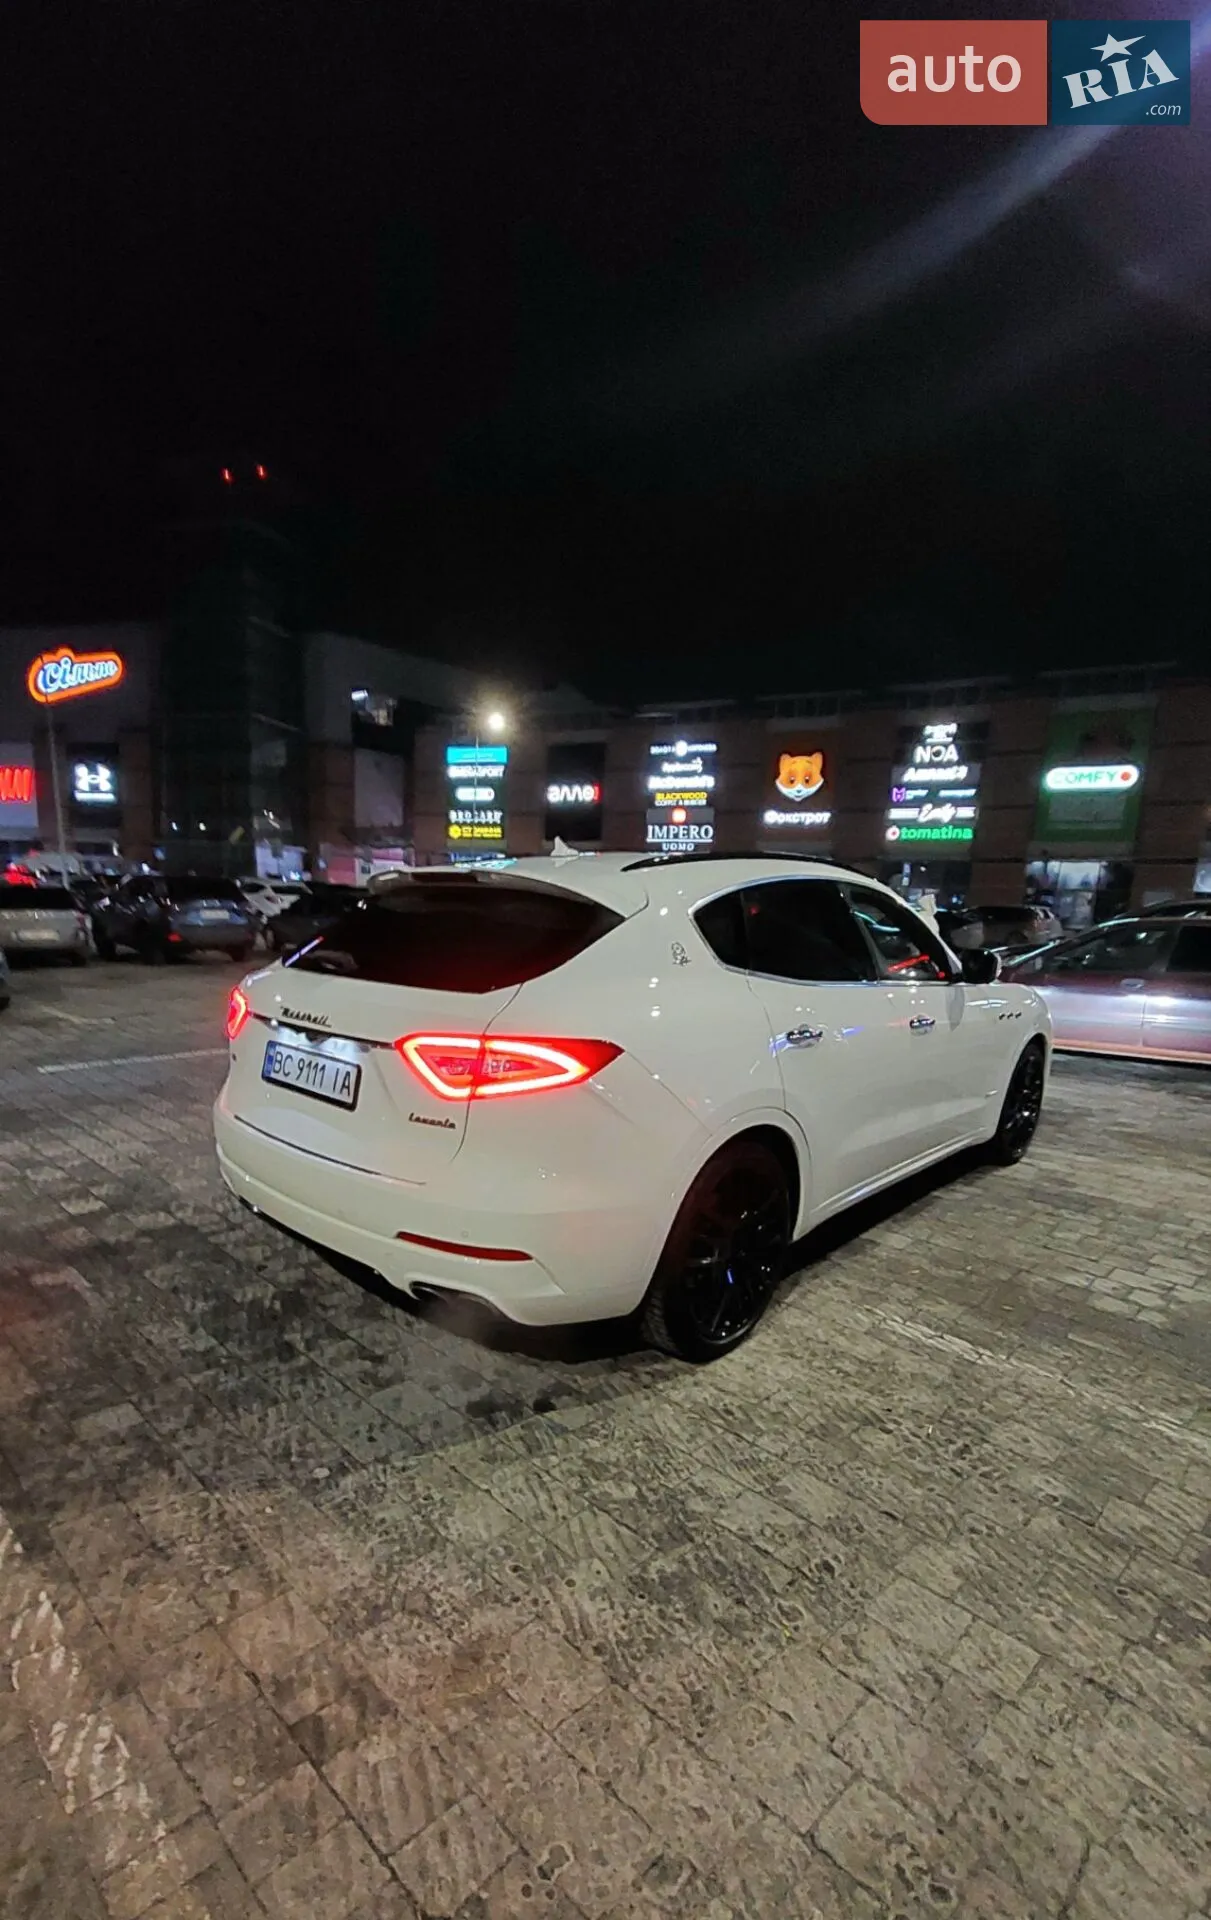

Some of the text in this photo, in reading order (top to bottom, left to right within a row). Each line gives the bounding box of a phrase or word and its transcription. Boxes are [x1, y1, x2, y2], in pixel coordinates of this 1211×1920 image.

[914, 744, 959, 763] NOA
[1053, 770, 1118, 785] COMFY
[655, 792, 708, 800] BLACKWOOD
[764, 810, 831, 825] Фокстрот
[647, 825, 714, 839] IMPERO
[901, 826, 973, 840] tomatina
[662, 843, 695, 851] UOMO
[273, 1051, 351, 1097] BC 9111 IA
